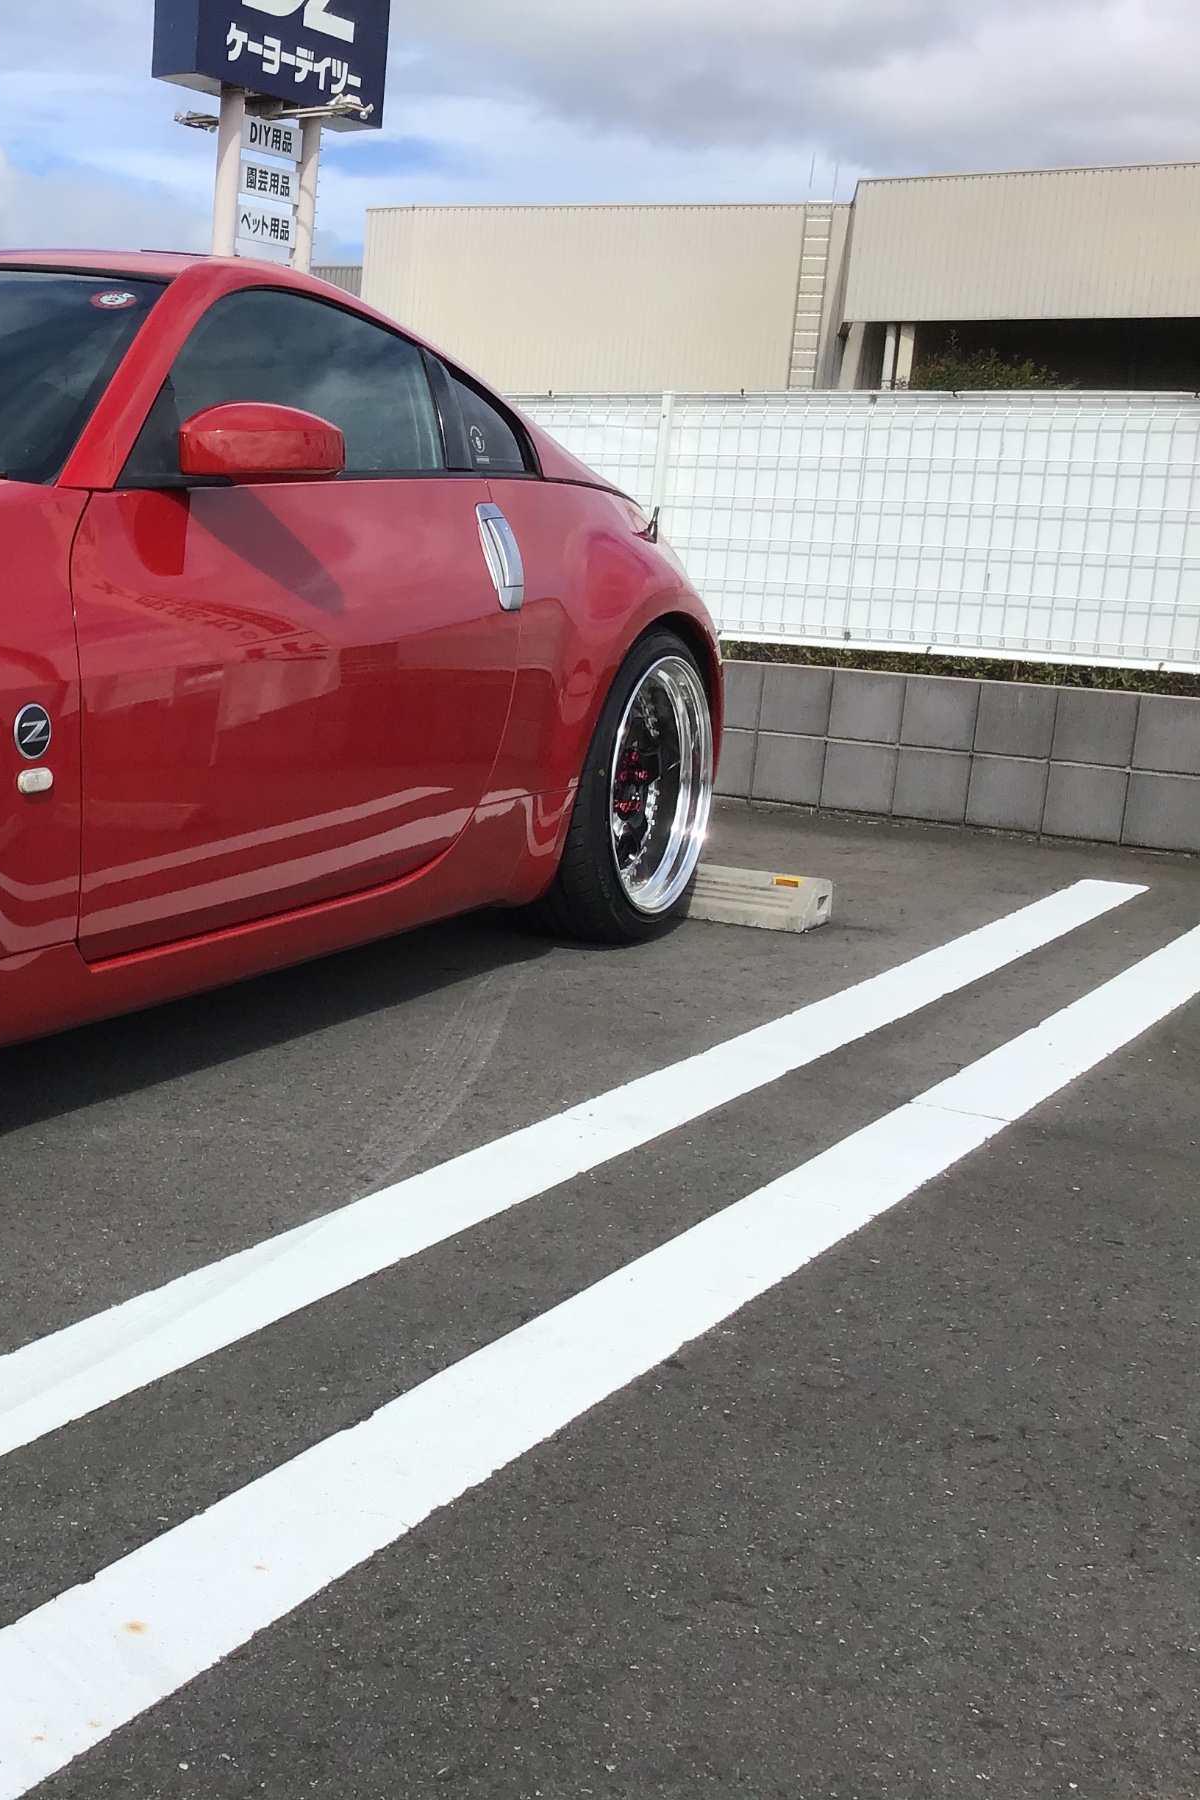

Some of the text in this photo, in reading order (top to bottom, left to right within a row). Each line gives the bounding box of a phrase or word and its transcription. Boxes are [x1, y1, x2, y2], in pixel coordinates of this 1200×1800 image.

[226, 22, 362, 94] ケーヨーデイツー
[250, 122, 292, 153] DIY用品
[246, 166, 290, 198] 園芸用品
[241, 212, 290, 242] ペット用品
